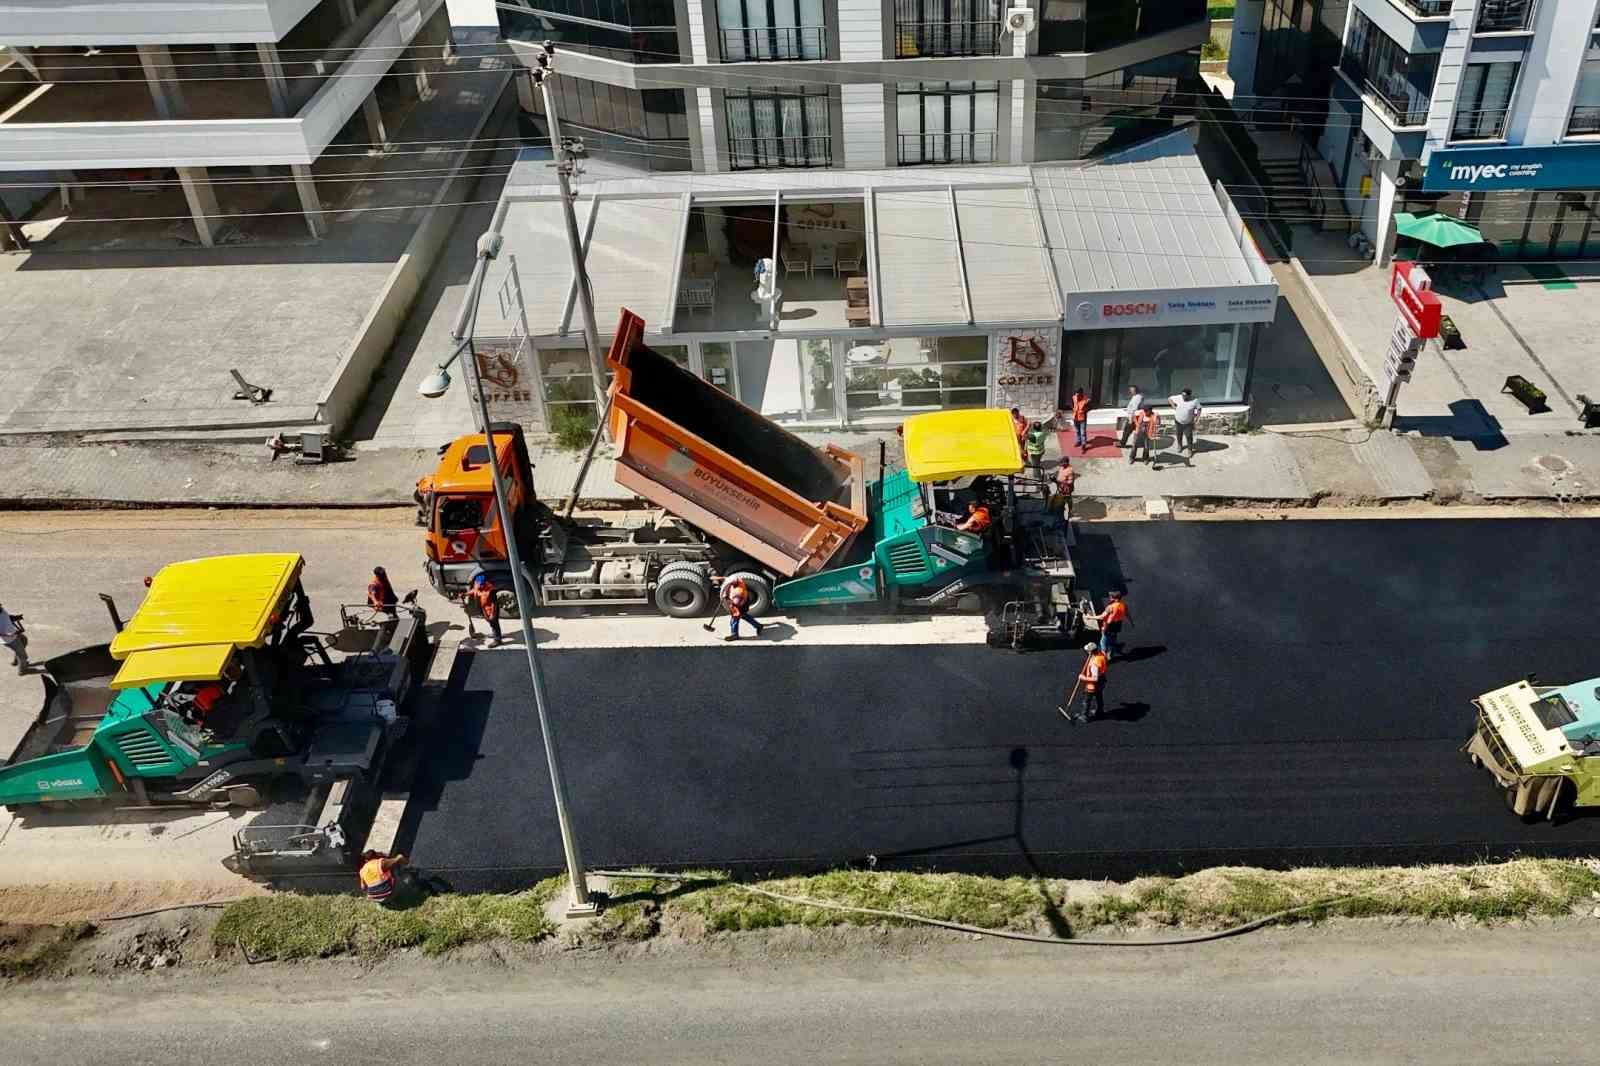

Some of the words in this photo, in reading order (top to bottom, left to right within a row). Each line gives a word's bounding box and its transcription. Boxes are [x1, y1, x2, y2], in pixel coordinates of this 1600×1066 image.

[1450, 164, 1508, 183] myec
[1103, 303, 1157, 316] BOSCH
[998, 375, 1053, 386] COFFEE
